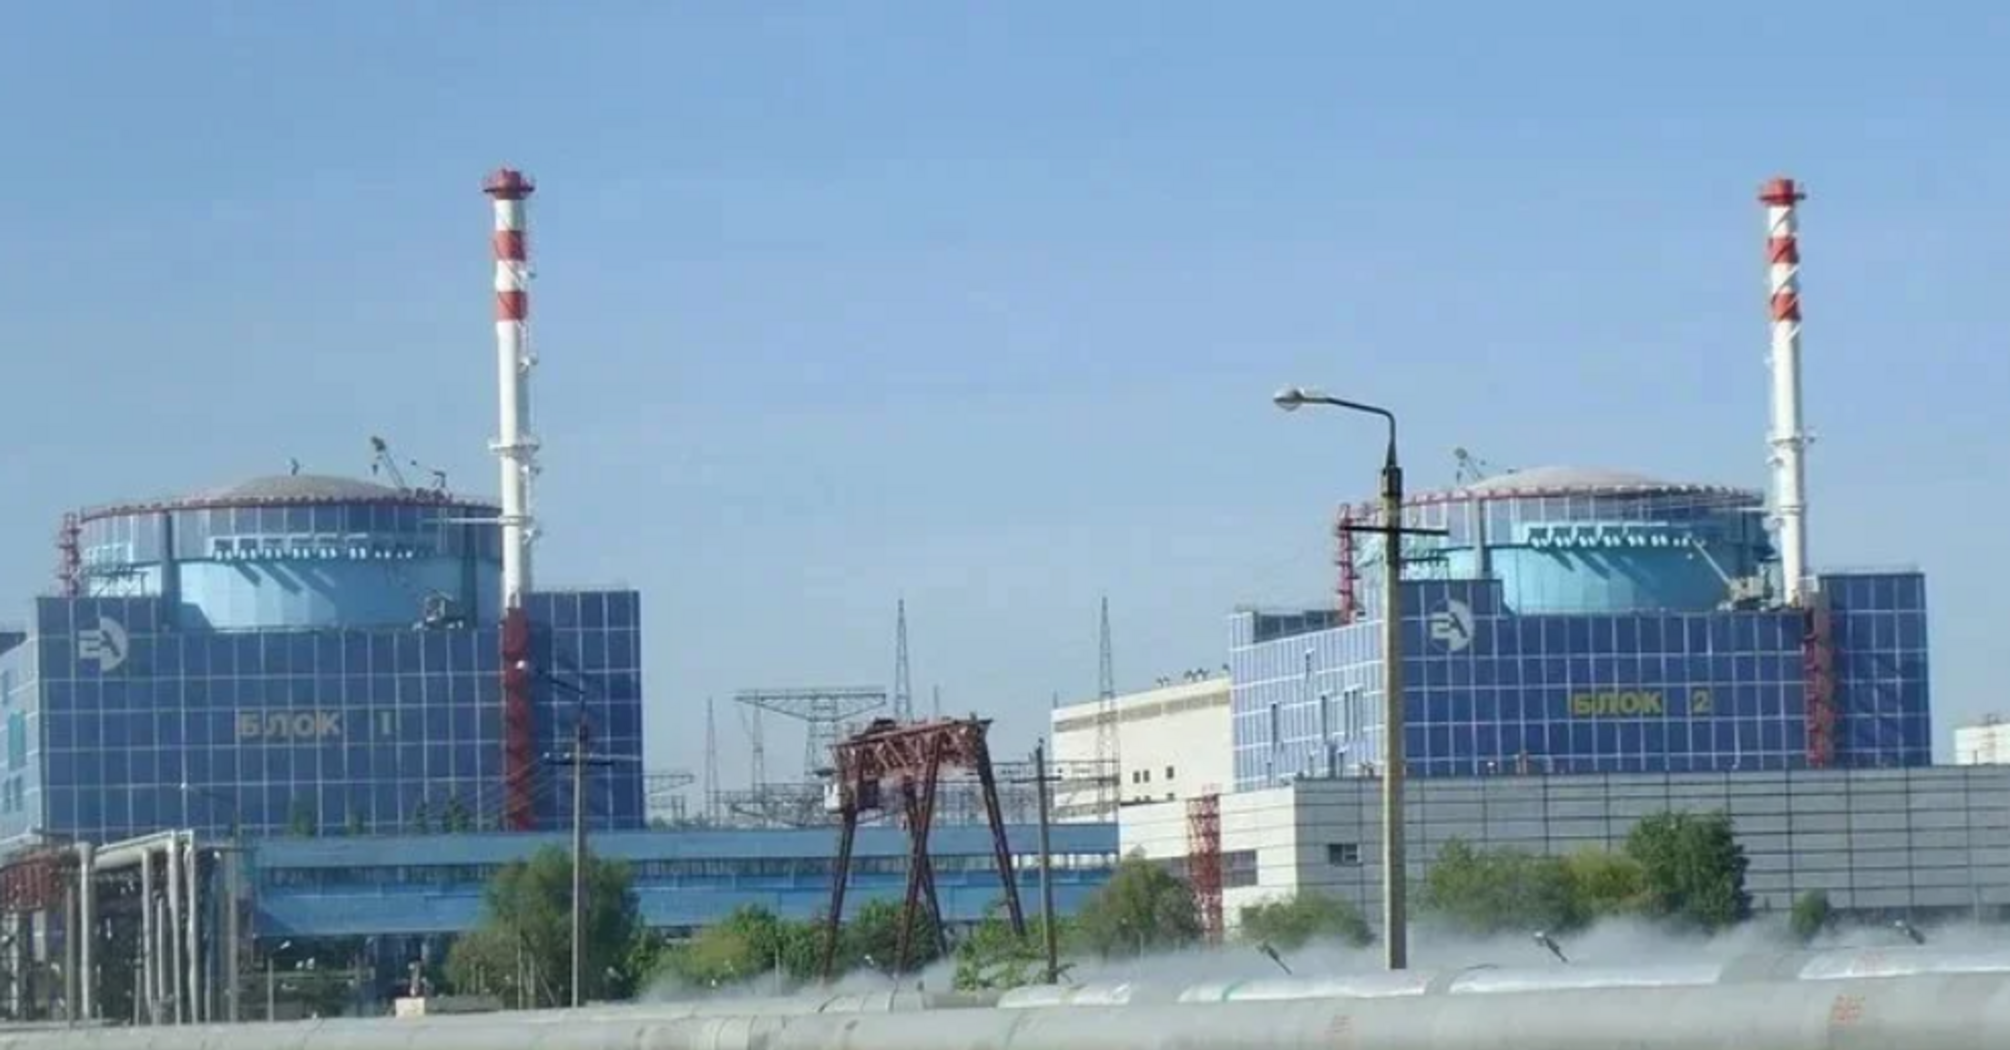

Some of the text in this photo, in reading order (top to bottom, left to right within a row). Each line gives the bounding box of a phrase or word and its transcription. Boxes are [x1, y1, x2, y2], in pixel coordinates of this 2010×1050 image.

[1573, 690, 1711, 715] БЛОК 2
[238, 712, 341, 737] БЛОК
